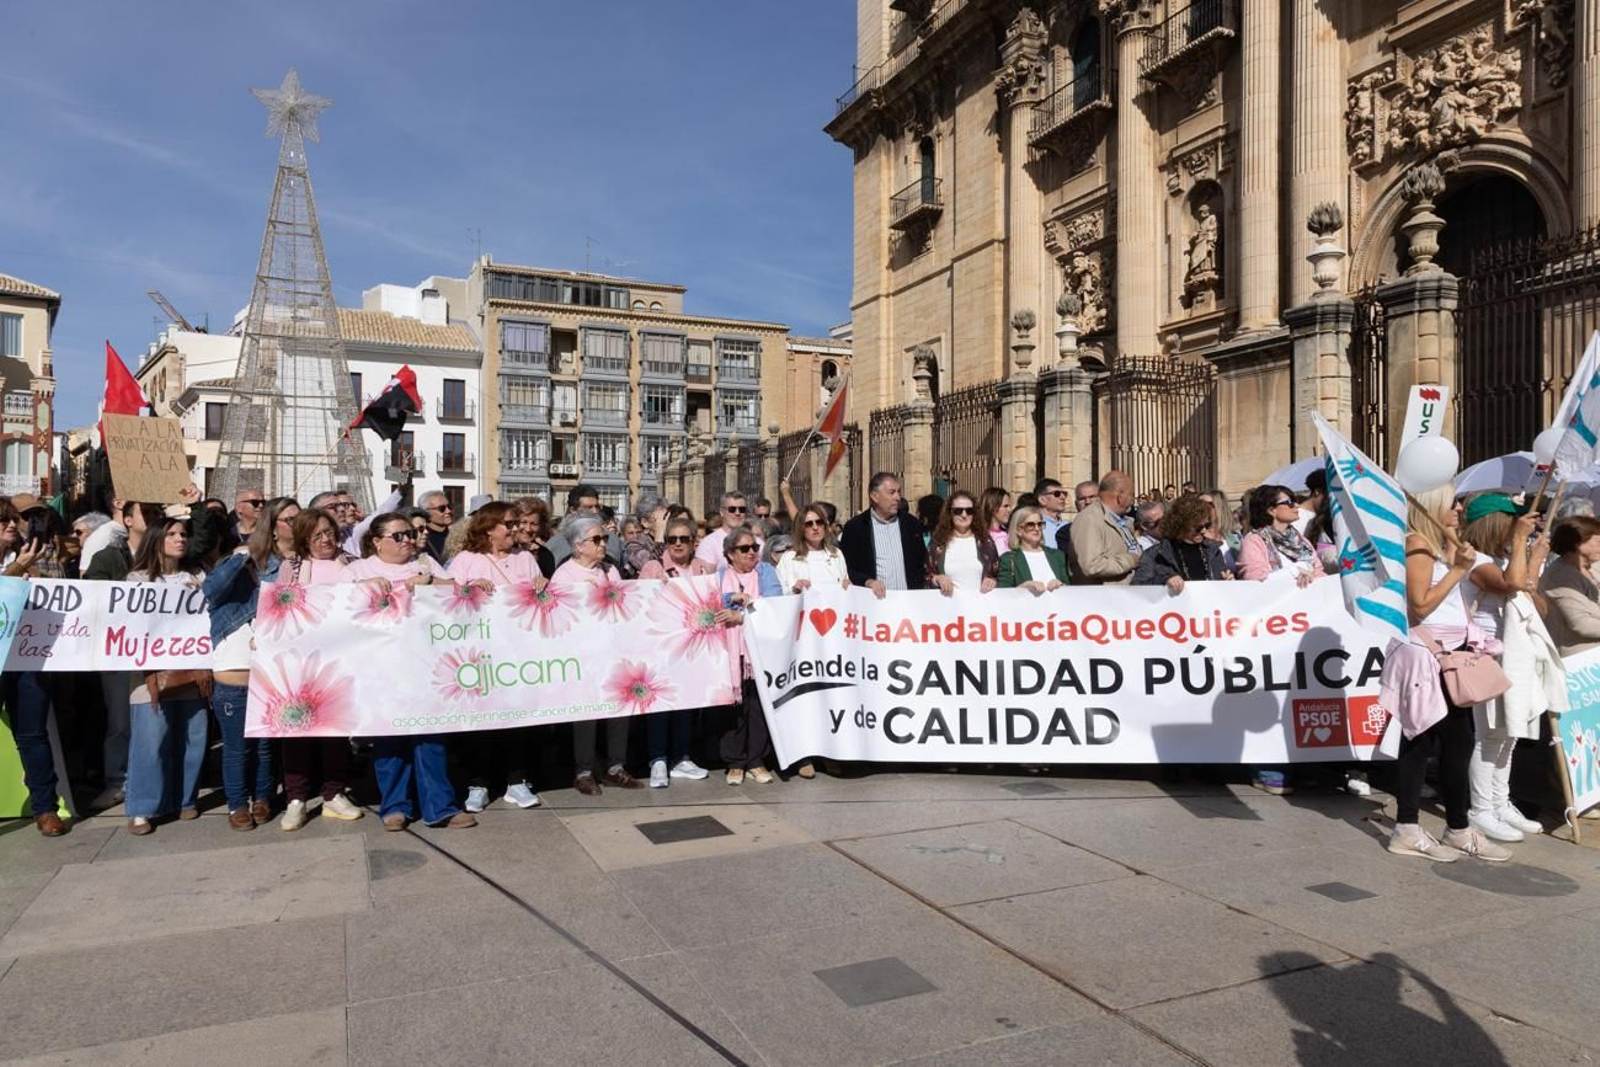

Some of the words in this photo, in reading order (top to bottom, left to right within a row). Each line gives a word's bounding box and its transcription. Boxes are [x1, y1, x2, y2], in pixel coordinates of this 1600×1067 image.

[139, 420, 150, 436] A
[155, 420, 178, 439] LA
[1418, 402, 1434, 438] US
[140, 453, 154, 471] A
[157, 455, 179, 471] LA
[18, 638, 53, 658] las
[104, 625, 212, 667] Mujeres
[430, 622, 471, 645] por
[457, 653, 581, 697] ajicam
[861, 656, 878, 680] la
[886, 657, 1125, 696] SANIDAD
[829, 709, 845, 734] y
[854, 704, 877, 729] de
[882, 706, 1121, 746] CALIDAD
[1299, 711, 1341, 727] PSOE
